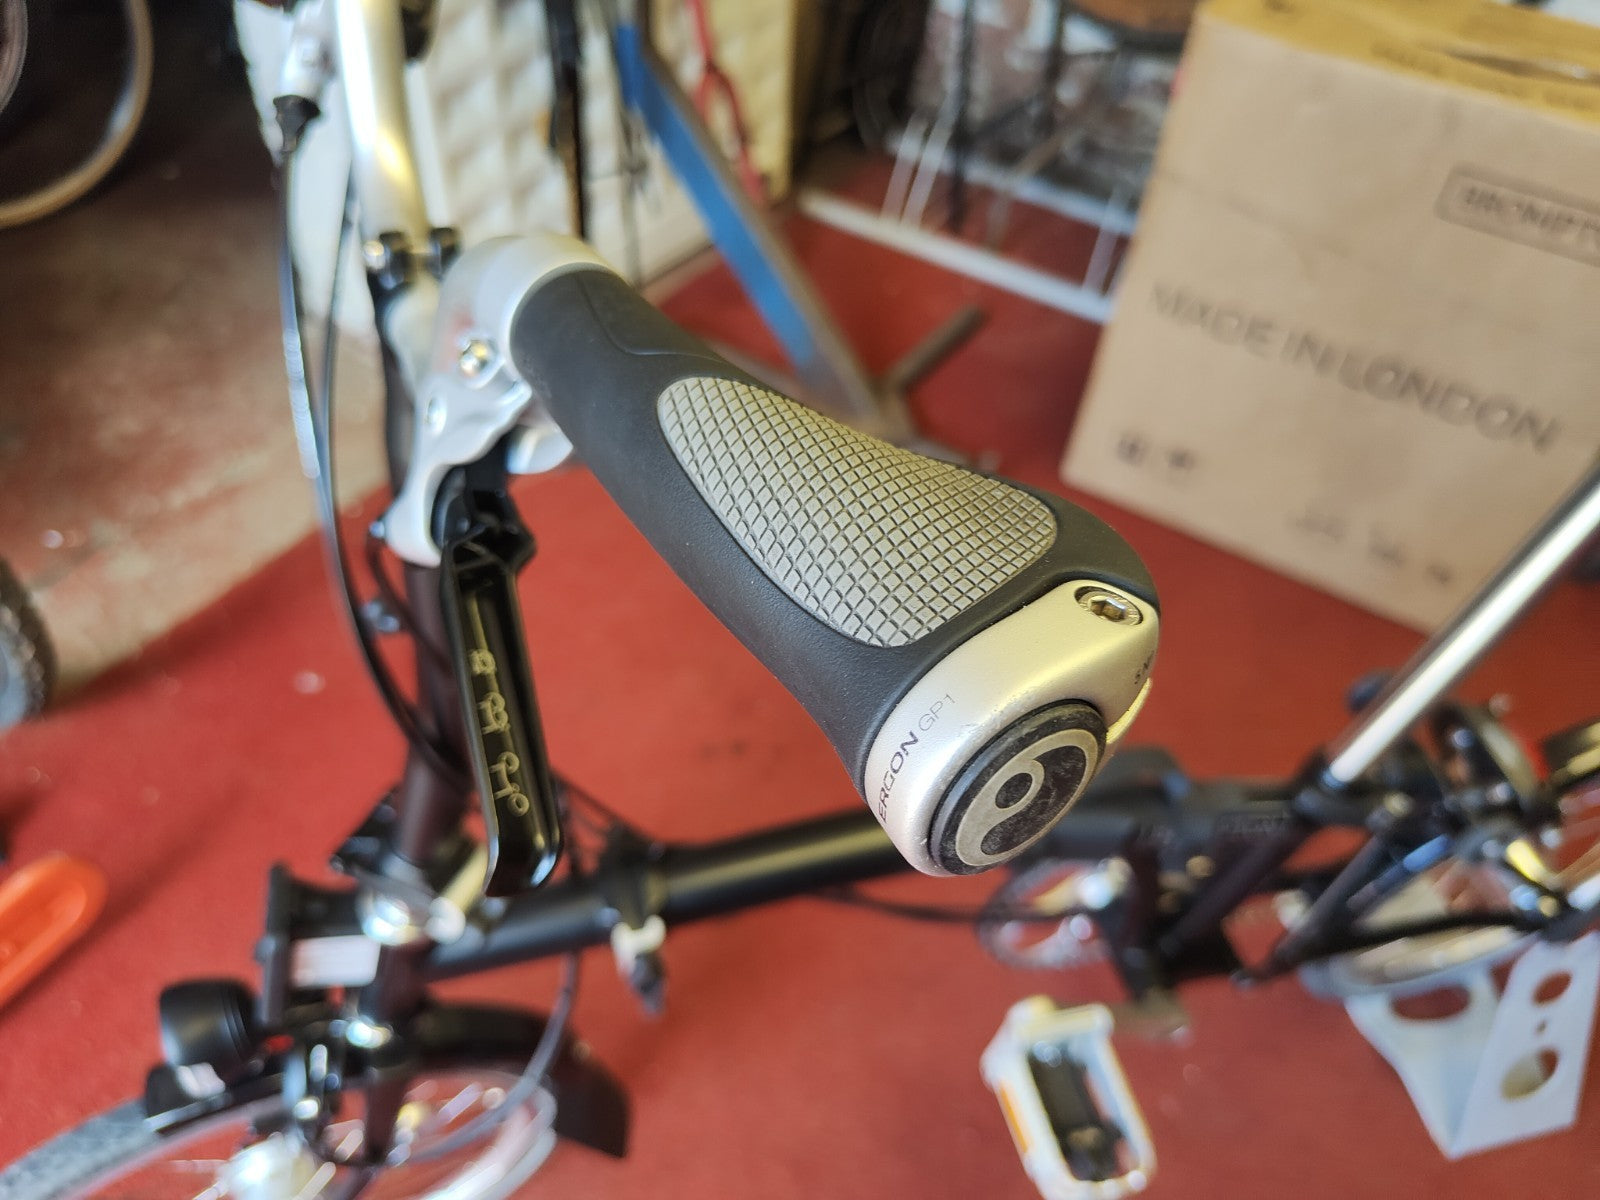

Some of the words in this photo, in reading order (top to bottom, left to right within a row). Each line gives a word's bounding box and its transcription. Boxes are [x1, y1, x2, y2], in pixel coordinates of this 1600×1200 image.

[1279, 328, 1339, 378] IN
[1338, 350, 1562, 455] LONDON
[879, 730, 919, 823] ERGON
[918, 693, 956, 732] GP1
